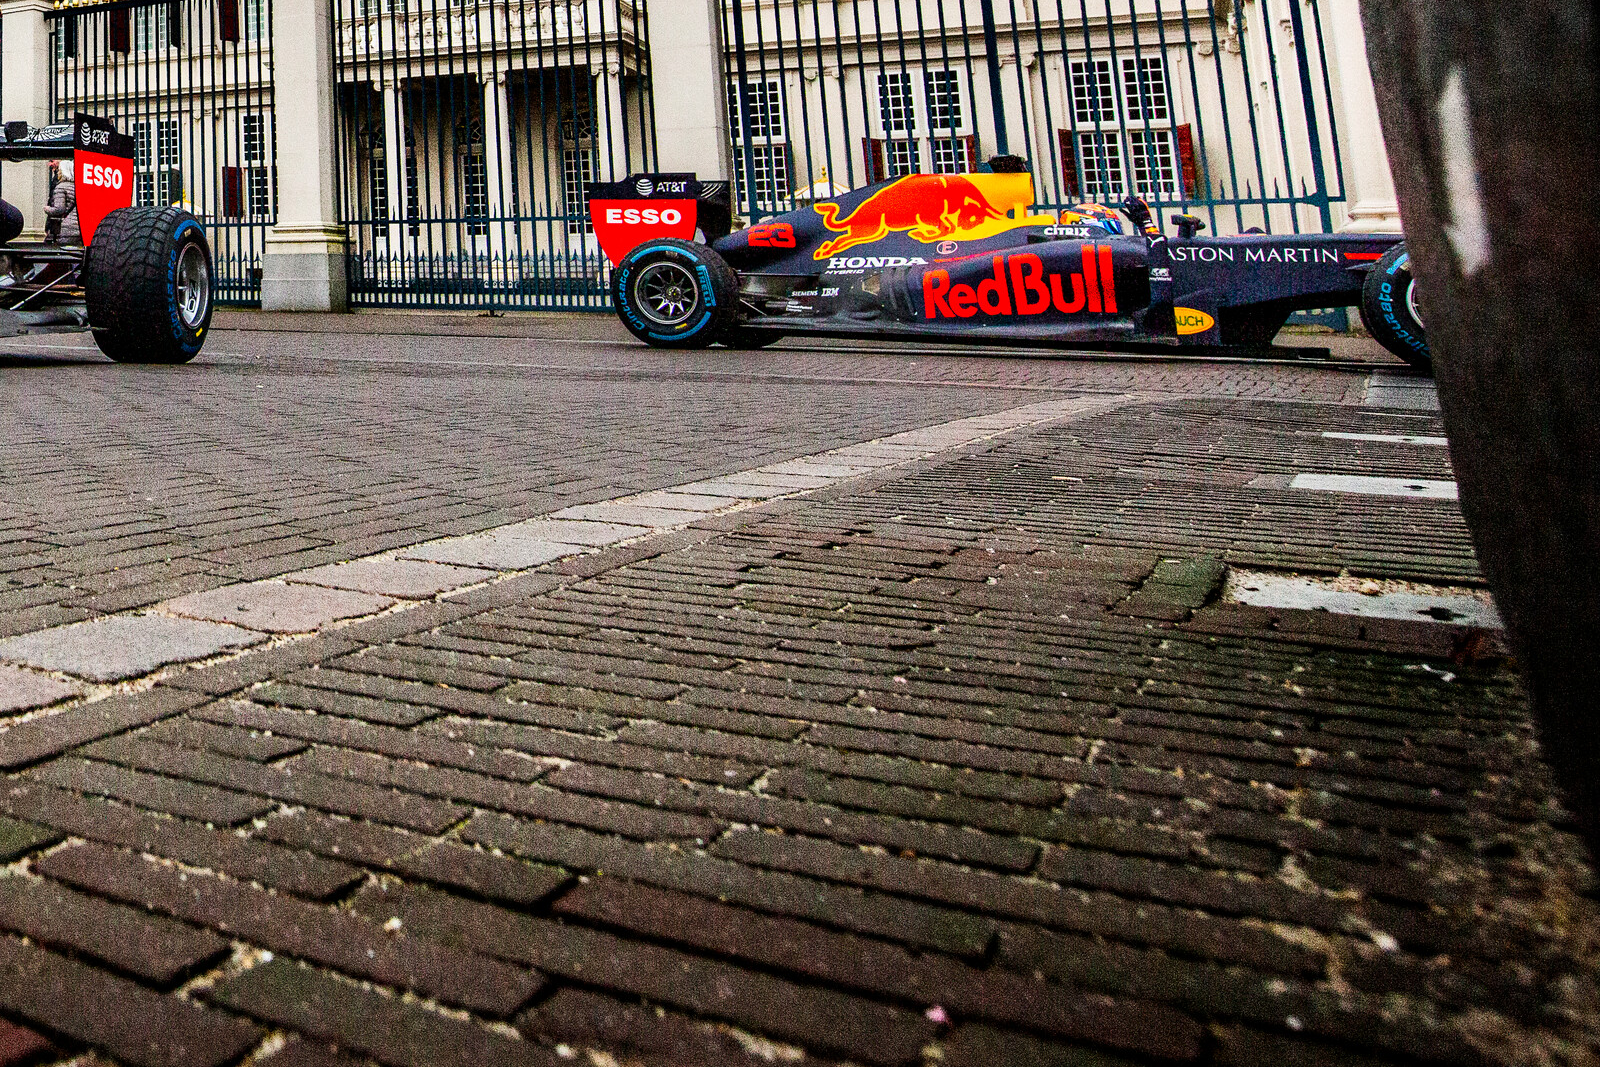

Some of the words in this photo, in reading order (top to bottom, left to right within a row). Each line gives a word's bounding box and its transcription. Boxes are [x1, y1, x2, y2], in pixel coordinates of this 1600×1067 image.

[82, 163, 123, 190] ESSO
[656, 181, 688, 194] AT&T
[605, 208, 682, 225] ESSO
[826, 256, 929, 269] HONDA
[1245, 248, 1340, 263] MARTIN
[695, 264, 717, 307] PIRELLI
[821, 287, 840, 298] IBM
[619, 268, 647, 331] Cinturato
[1174, 315, 1205, 327] AUCH
